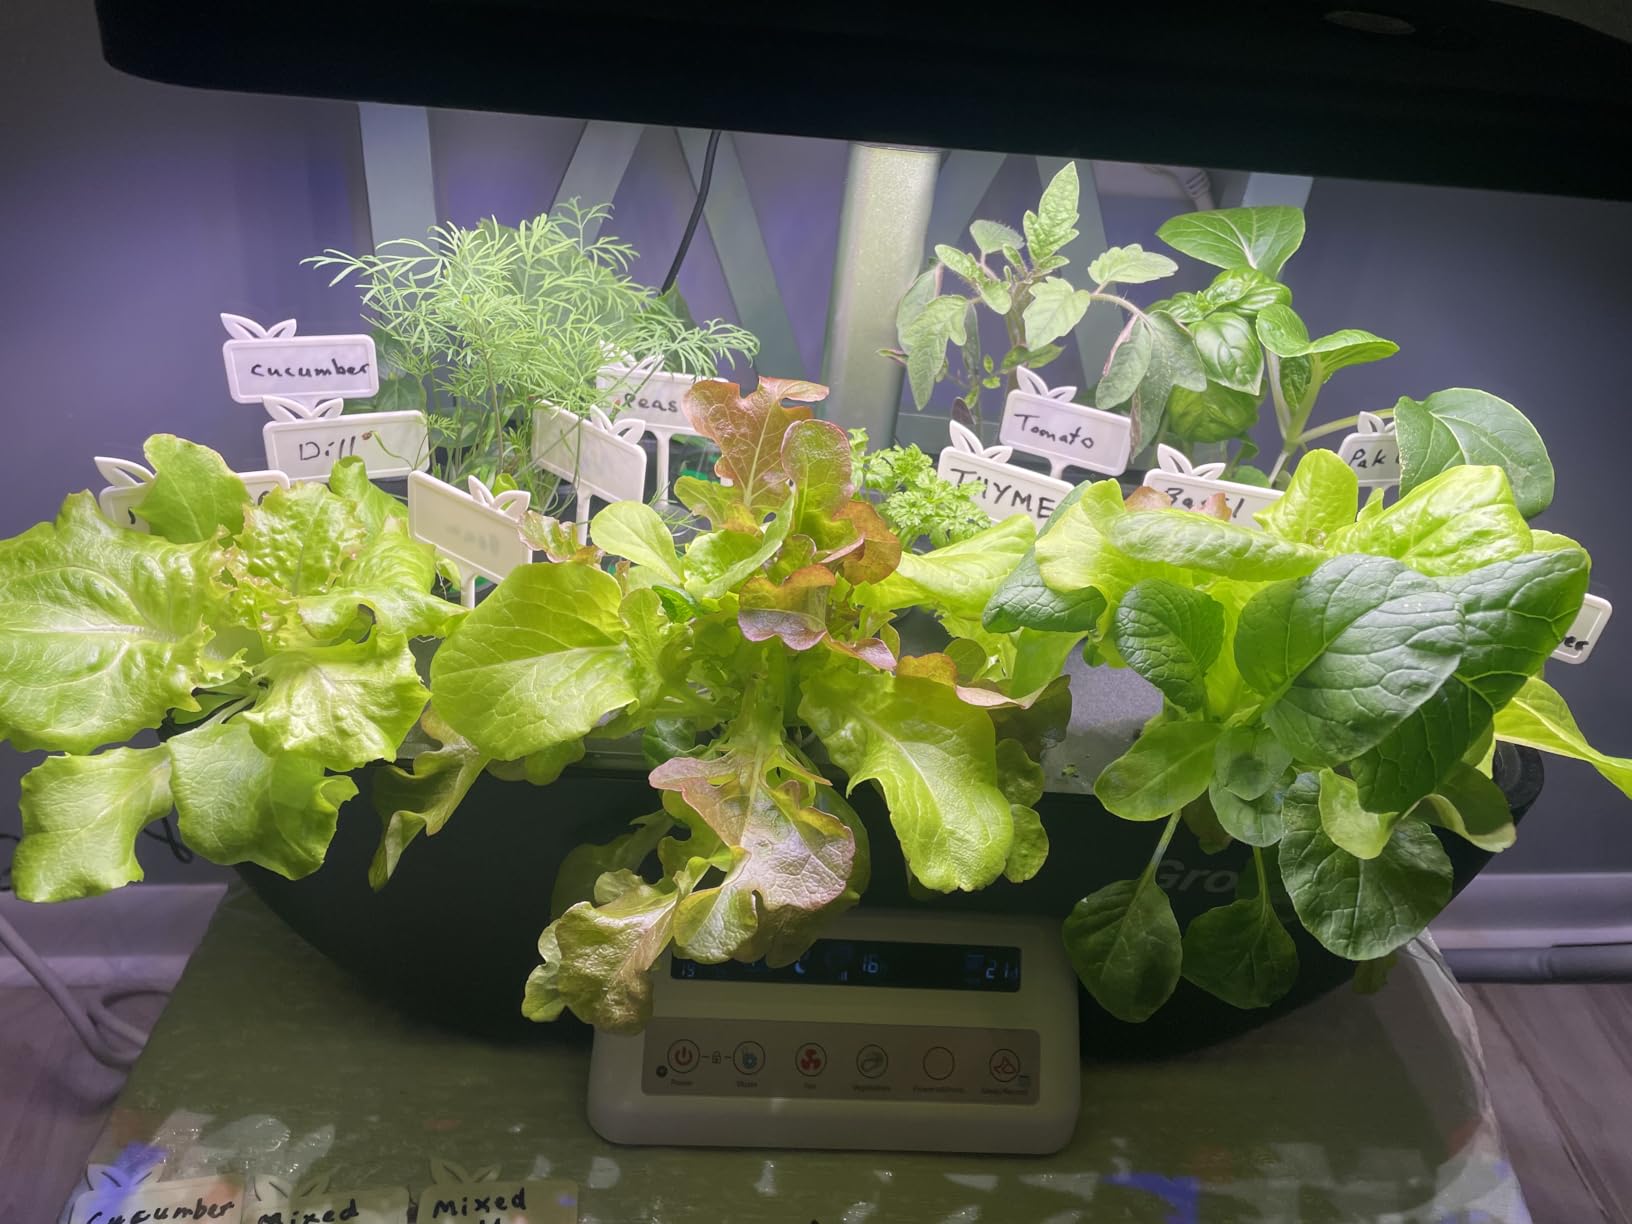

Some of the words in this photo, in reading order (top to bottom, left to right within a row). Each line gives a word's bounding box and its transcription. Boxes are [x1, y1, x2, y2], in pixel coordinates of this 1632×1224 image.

[1013, 413, 1095, 450] Tomato
[299, 436, 356, 461] Dill
[432, 1186, 527, 1219] Mixed
